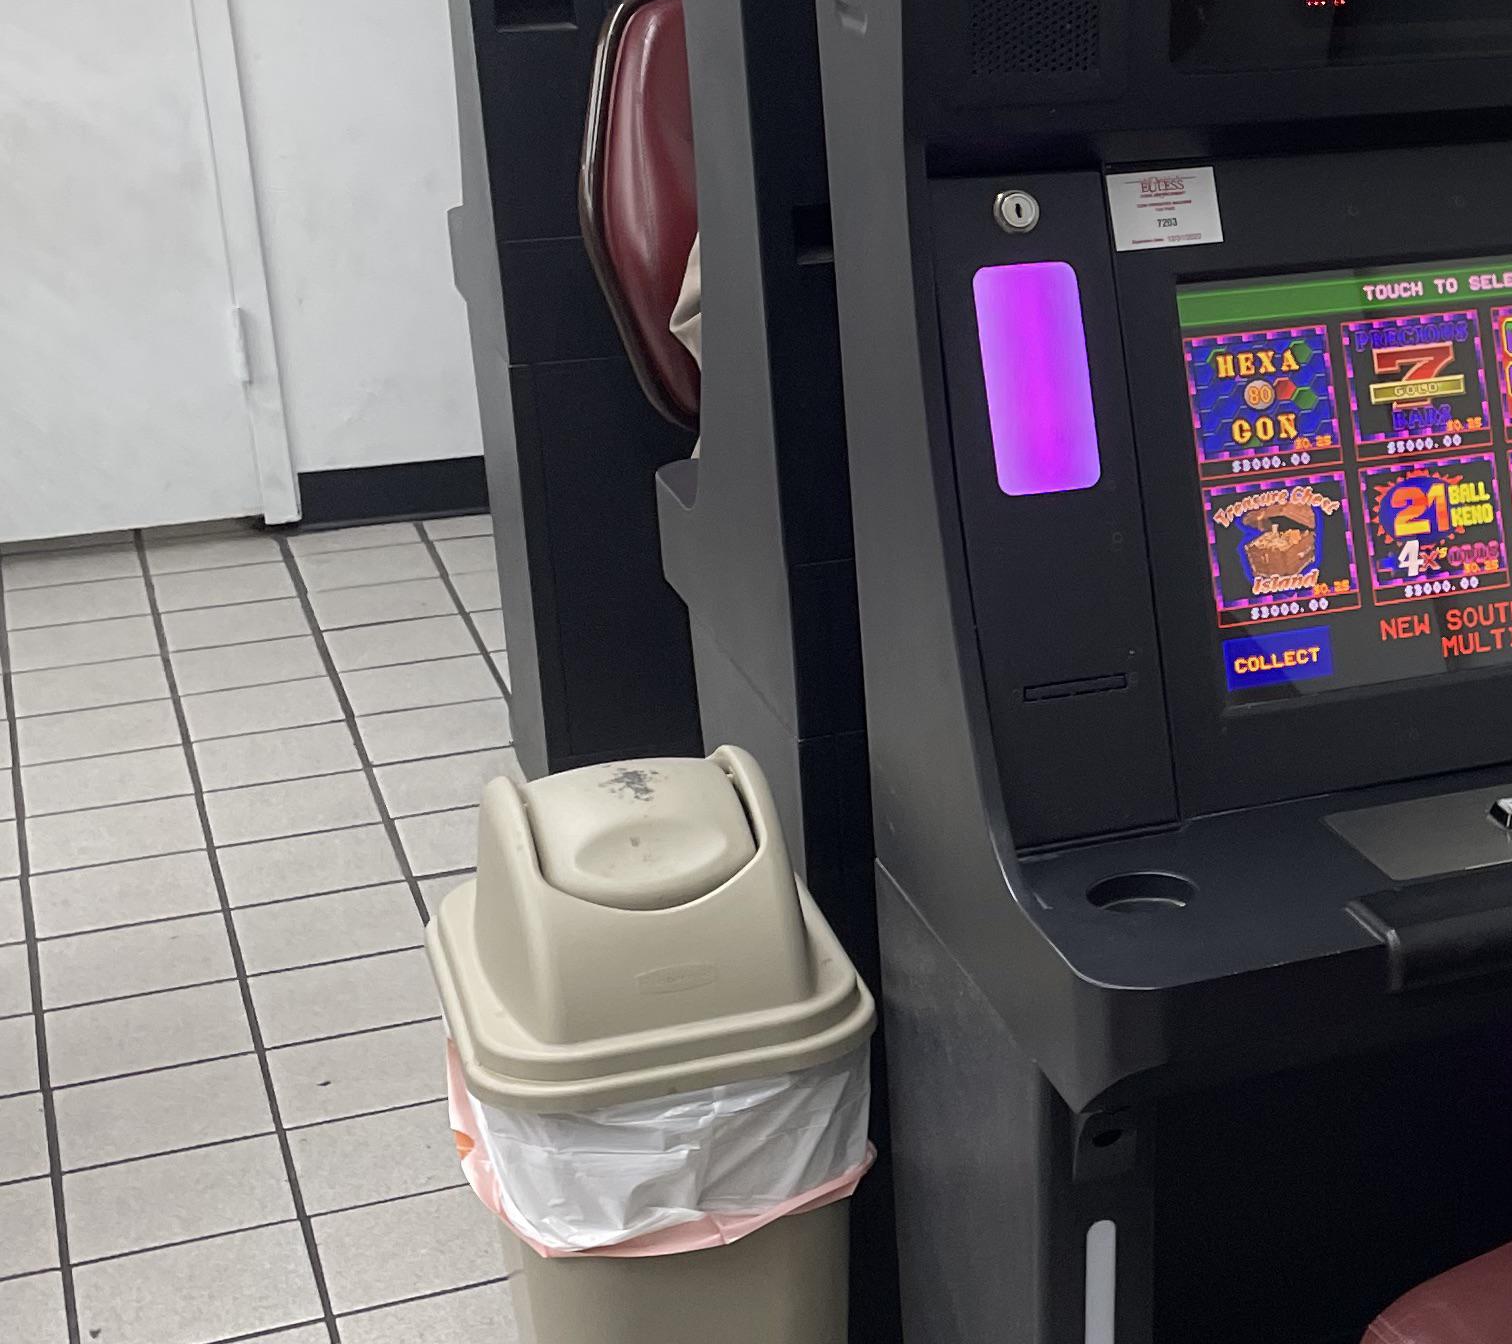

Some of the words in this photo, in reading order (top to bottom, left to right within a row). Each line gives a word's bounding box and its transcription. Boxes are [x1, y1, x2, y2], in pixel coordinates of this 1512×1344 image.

[1362, 280, 1424, 302] TOUCH
[1434, 277, 1459, 294] TO
[1354, 321, 1469, 353] PRECIOUS
[1216, 348, 1301, 379] HEXA
[1249, 384, 1272, 406] 80
[1393, 383, 1439, 397] GOLD
[1231, 412, 1299, 445] GON
[1392, 404, 1452, 432] BARS
[1212, 489, 1290, 528] Treasure
[1391, 482, 1451, 538] 21
[1447, 481, 1491, 505] BALL
[1450, 503, 1494, 528] KENO
[1252, 569, 1320, 596] Island
[1380, 613, 1431, 642] NEW
[1233, 646, 1321, 675] COLLECT
